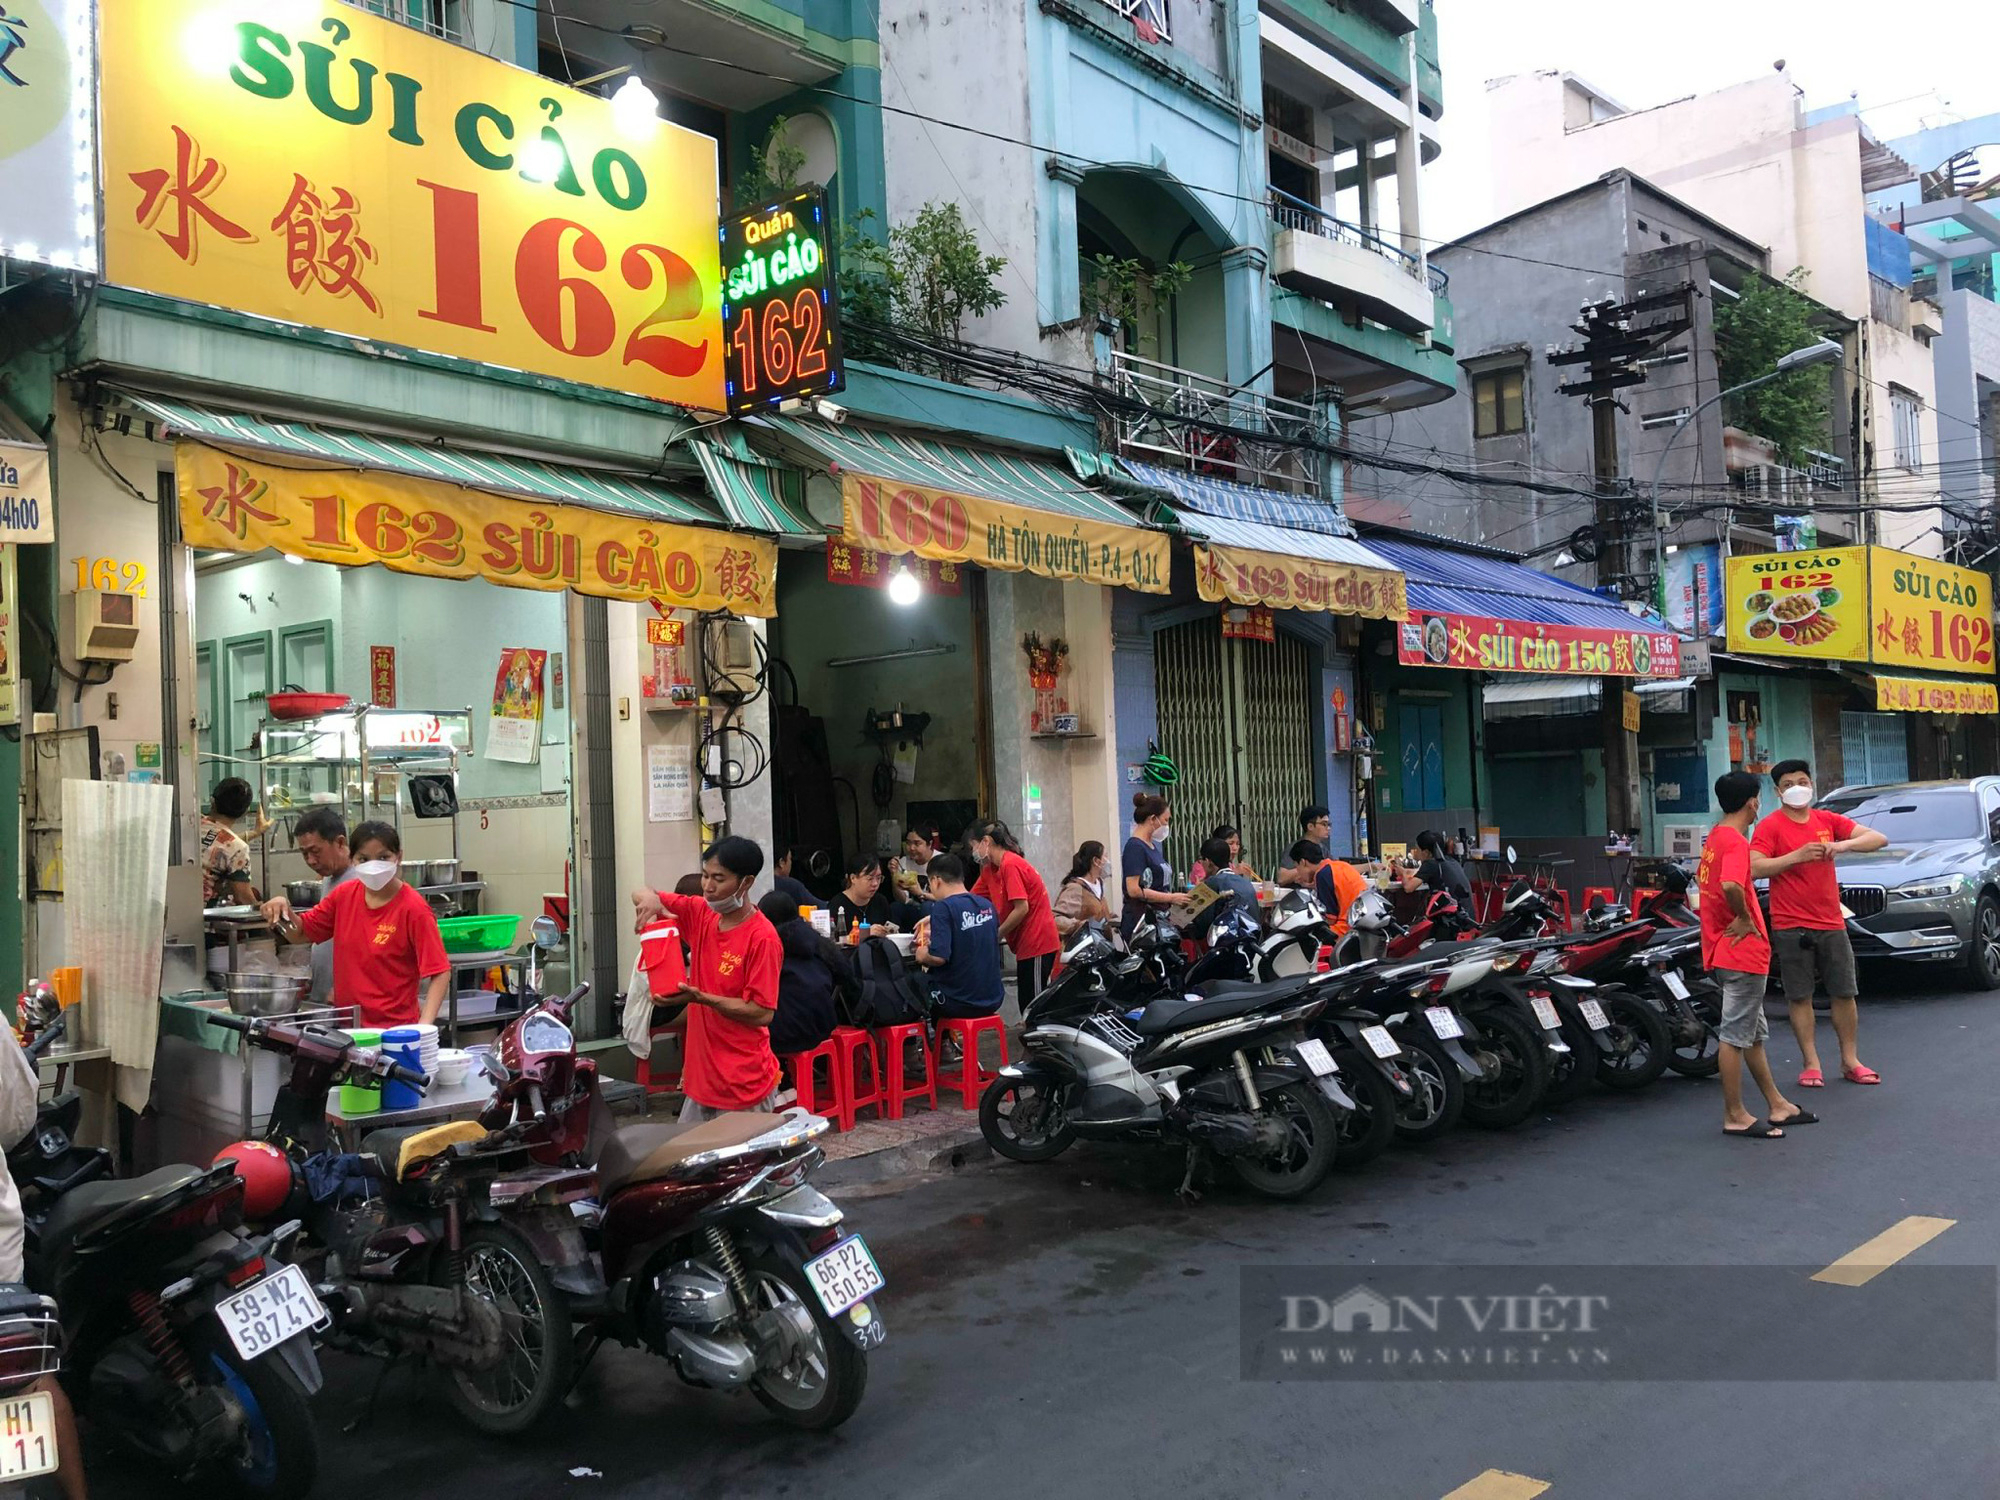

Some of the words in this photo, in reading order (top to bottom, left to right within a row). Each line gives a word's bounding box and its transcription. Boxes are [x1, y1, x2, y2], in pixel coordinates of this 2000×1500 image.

[229, 18, 425, 147] SỦI
[454, 97, 648, 212] CẢO
[745, 211, 794, 245] Quán
[128, 125, 385, 320] 水餃
[416, 178, 709, 378] 162
[728, 250, 768, 300] SỦI
[770, 232, 819, 286] CẢO
[734, 288, 826, 393] 162
[0, 497, 39, 530] 4h00
[197, 462, 290, 541] 水
[300, 494, 466, 566] 162
[481, 511, 582, 580] SỦI
[595, 528, 702, 596] CẢO
[857, 480, 971, 553] 160
[987, 515, 1007, 561] HÀ
[1012, 519, 1041, 568] TÔN
[1045, 523, 1090, 576] QUYỀN
[1102, 544, 1121, 579] P.4
[71, 556, 147, 599] 162
[1200, 549, 1231, 592] 水
[1234, 563, 1290, 600] 162
[1294, 562, 1331, 606] SỦI
[1334, 569, 1376, 611] CẢO
[1752, 558, 1788, 574] SỦI
[1794, 554, 1841, 570] CẢO
[1759, 572, 1834, 591] 162
[1893, 562, 1931, 598] SỦI
[1936, 572, 1977, 608] CẢO
[1451, 619, 1476, 665] 水
[1478, 622, 1516, 668] SỦI
[1521, 625, 1561, 670] CẢO
[1566, 639, 1611, 673] 156
[1612, 633, 1632, 671] 餃
[1654, 636, 1673, 655] 156
[1929, 609, 1992, 665] 162
[375, 652, 391, 708] 福星高
[1916, 687, 1958, 710] 162
[480, 809, 489, 830] 5
[719, 961, 735, 976] 162
[815, 1244, 862, 1285] 66-P2
[822, 1262, 879, 1308] 150.55
[230, 1275, 298, 1325] 59-M2
[238, 1296, 315, 1352] 587.41
[0, 1434, 46, 1476] .11
